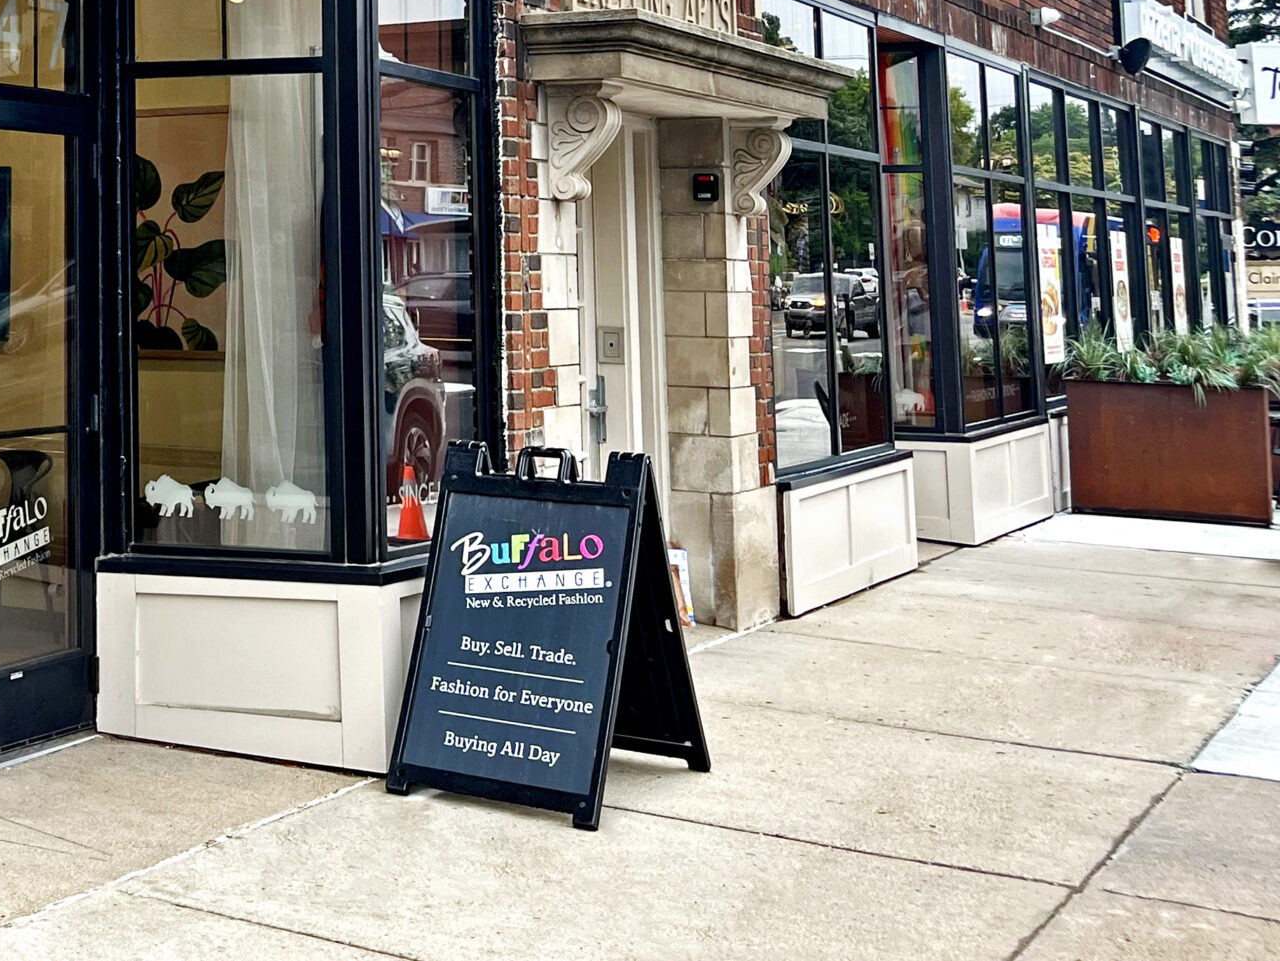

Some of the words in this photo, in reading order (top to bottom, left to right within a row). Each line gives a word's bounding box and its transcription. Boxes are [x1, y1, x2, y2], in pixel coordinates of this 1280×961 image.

[1261, 66, 1280, 100] T
[398, 481, 435, 509] SINCE
[467, 571, 601, 592] EXCHANGE
[466, 597, 491, 610] New
[492, 596, 504, 608] &
[506, 594, 557, 610] Recycled
[558, 592, 604, 606] Fashion
[460, 636, 492, 657] Buy.
[494, 640, 525, 659] Sell.
[530, 645, 577, 666] Trade.
[430, 676, 490, 700] Fashion
[493, 683, 517, 702] for
[520, 689, 594, 715] Everyone
[443, 731, 498, 758] Buying
[500, 739, 524, 759] All
[527, 744, 561, 767] Day
